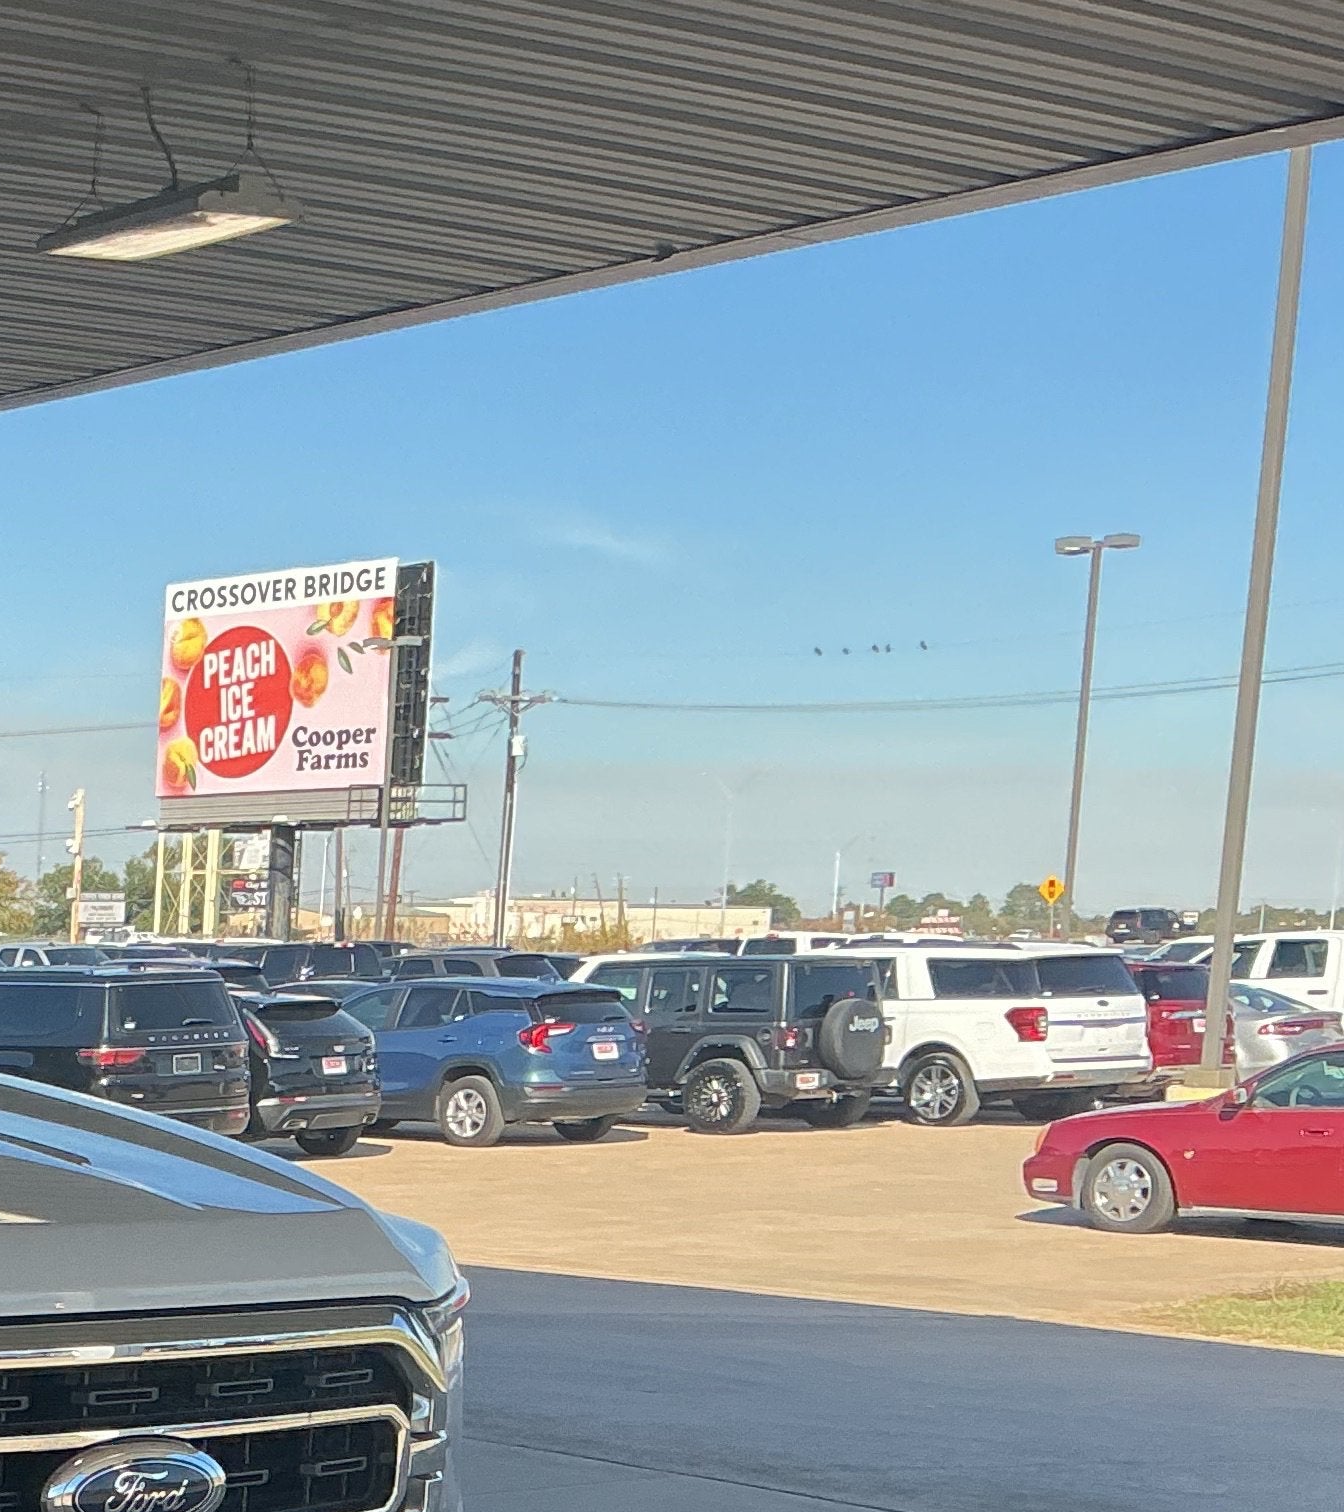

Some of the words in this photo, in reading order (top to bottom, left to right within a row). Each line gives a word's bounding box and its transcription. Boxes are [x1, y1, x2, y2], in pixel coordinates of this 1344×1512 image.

[171, 577, 296, 613] CROSSOVER
[304, 566, 387, 599] BRIDGE
[203, 639, 276, 689] PEACH
[220, 682, 255, 722] ICE
[199, 715, 276, 763] CREAM
[292, 726, 376, 750] Cooper
[296, 749, 369, 771] Farms
[849, 1015, 879, 1032] Jeep
